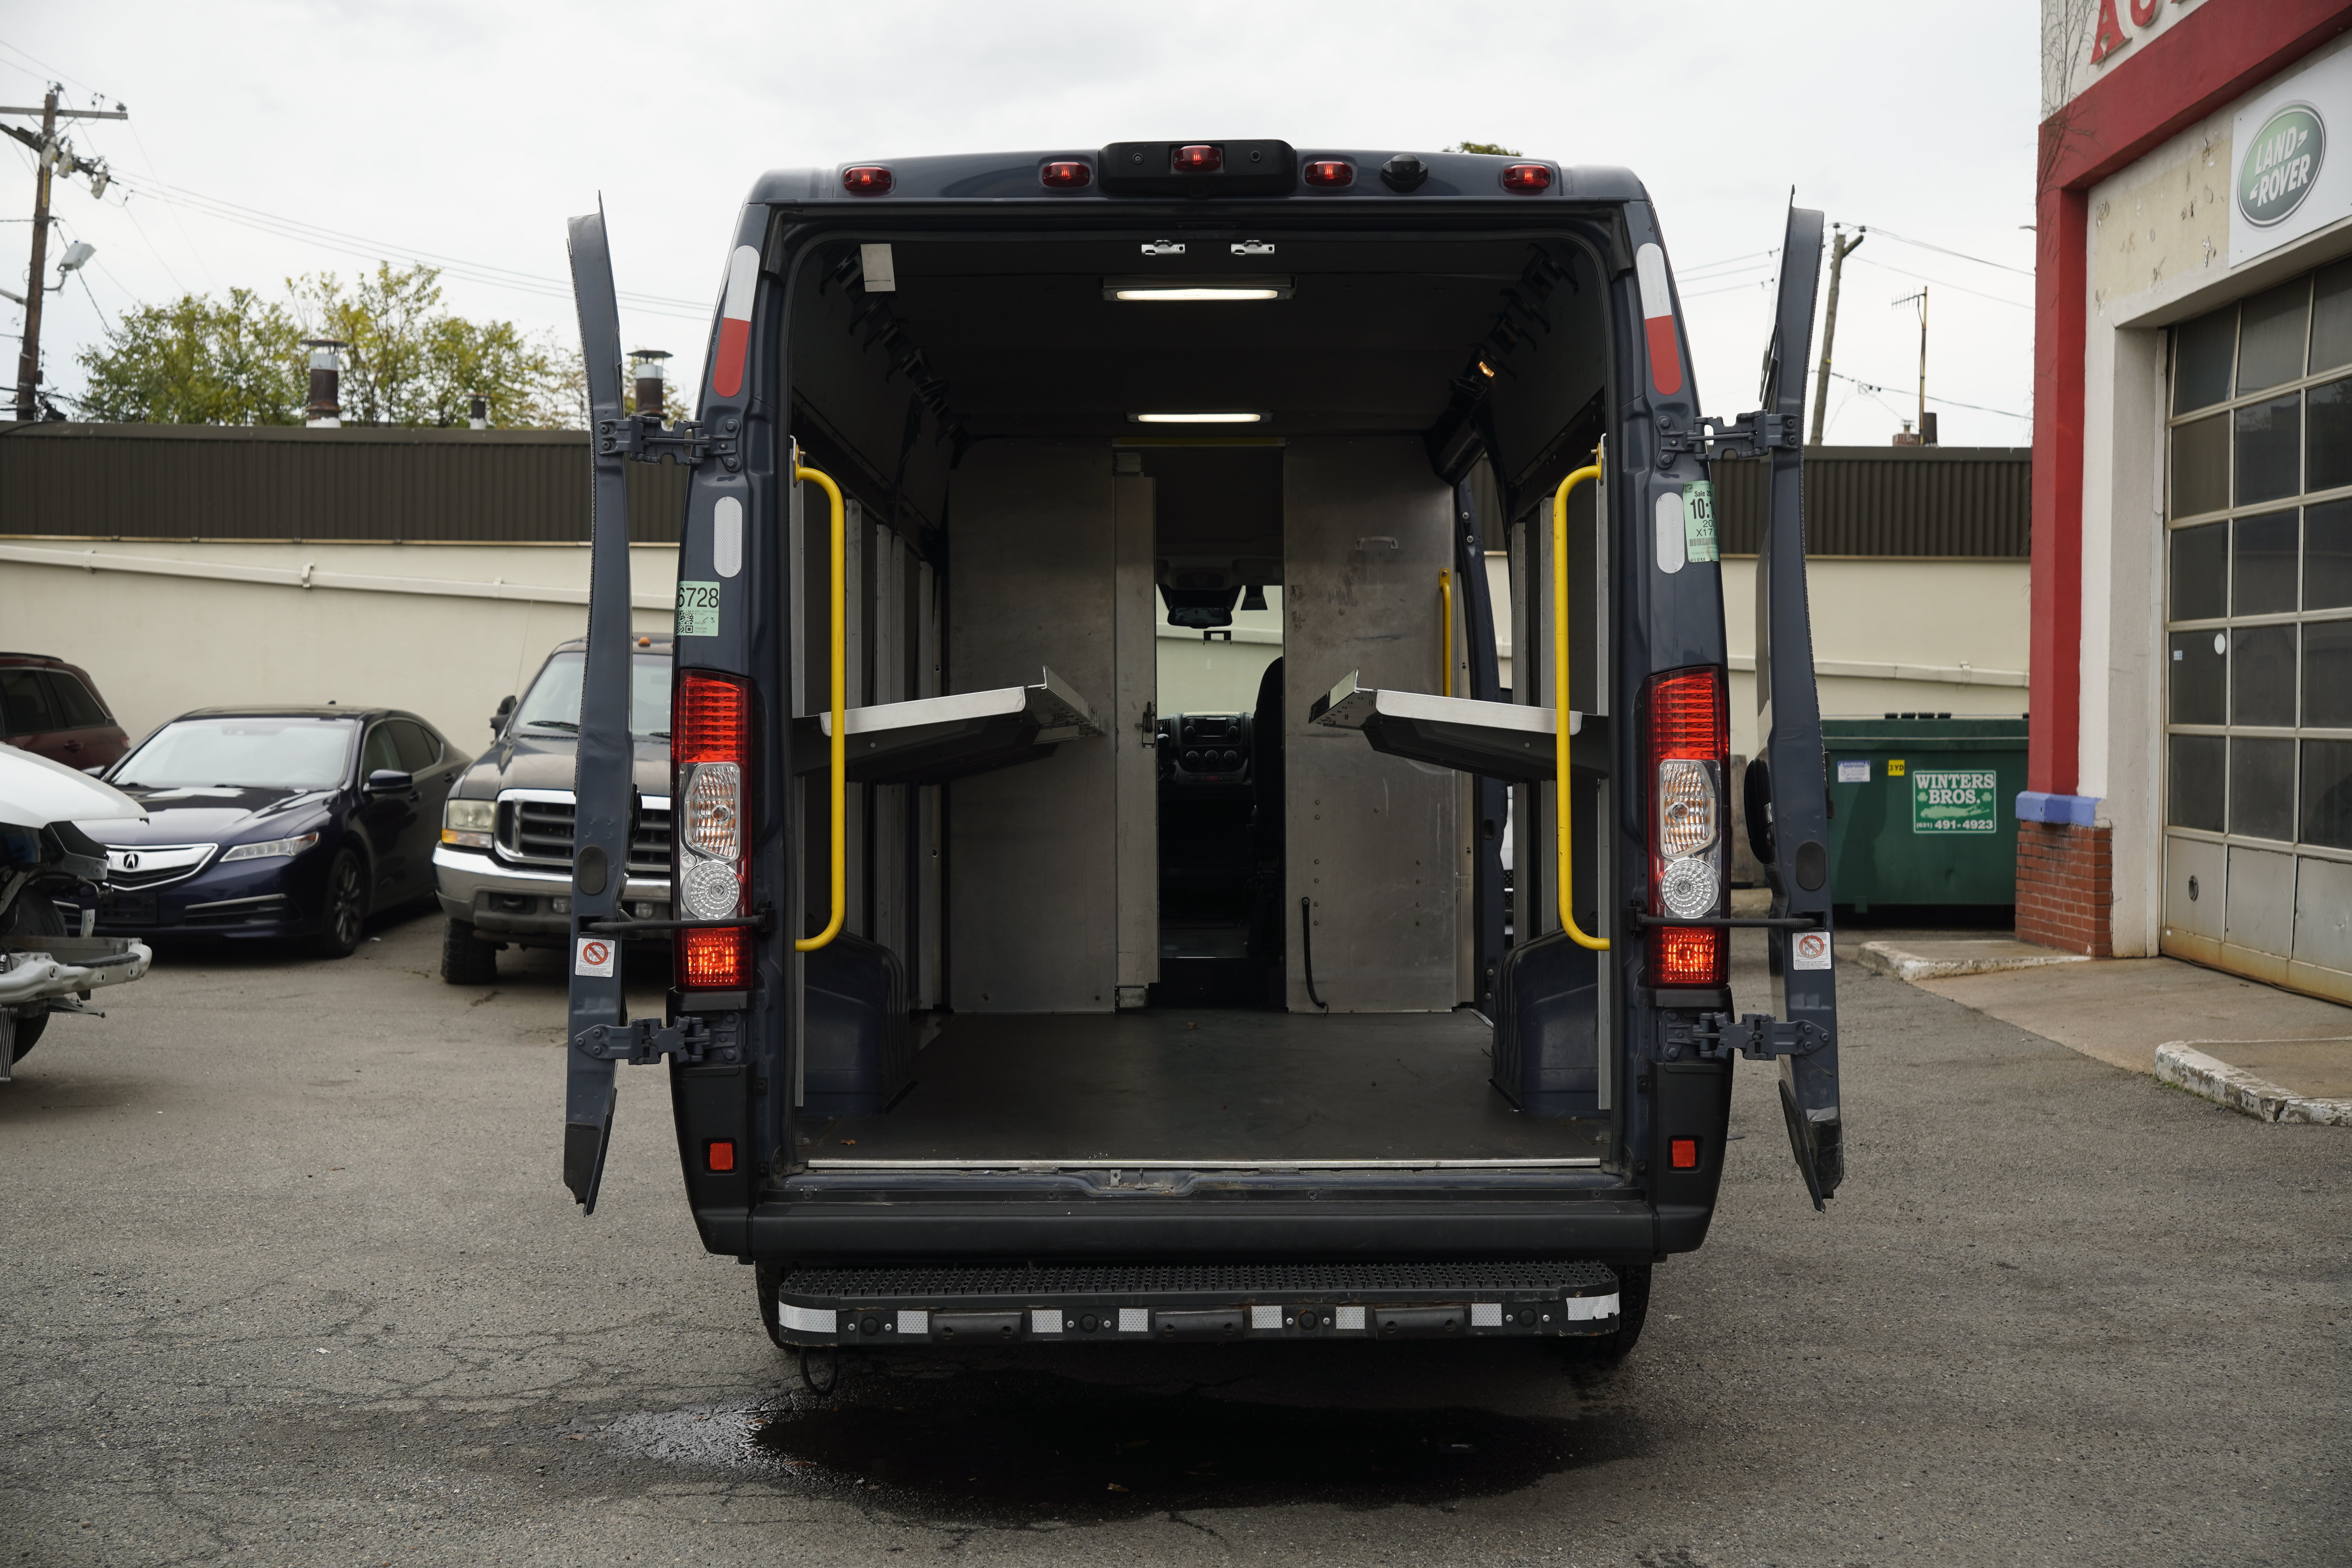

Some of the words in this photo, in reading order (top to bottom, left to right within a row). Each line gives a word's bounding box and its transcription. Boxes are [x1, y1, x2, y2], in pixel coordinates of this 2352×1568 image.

[2254, 126, 2297, 176] LAND
[2257, 154, 2310, 207] ROVER
[677, 587, 719, 608] 6728
[1915, 774, 1994, 789] WINTERS
[1929, 789, 1980, 804] BROS.
